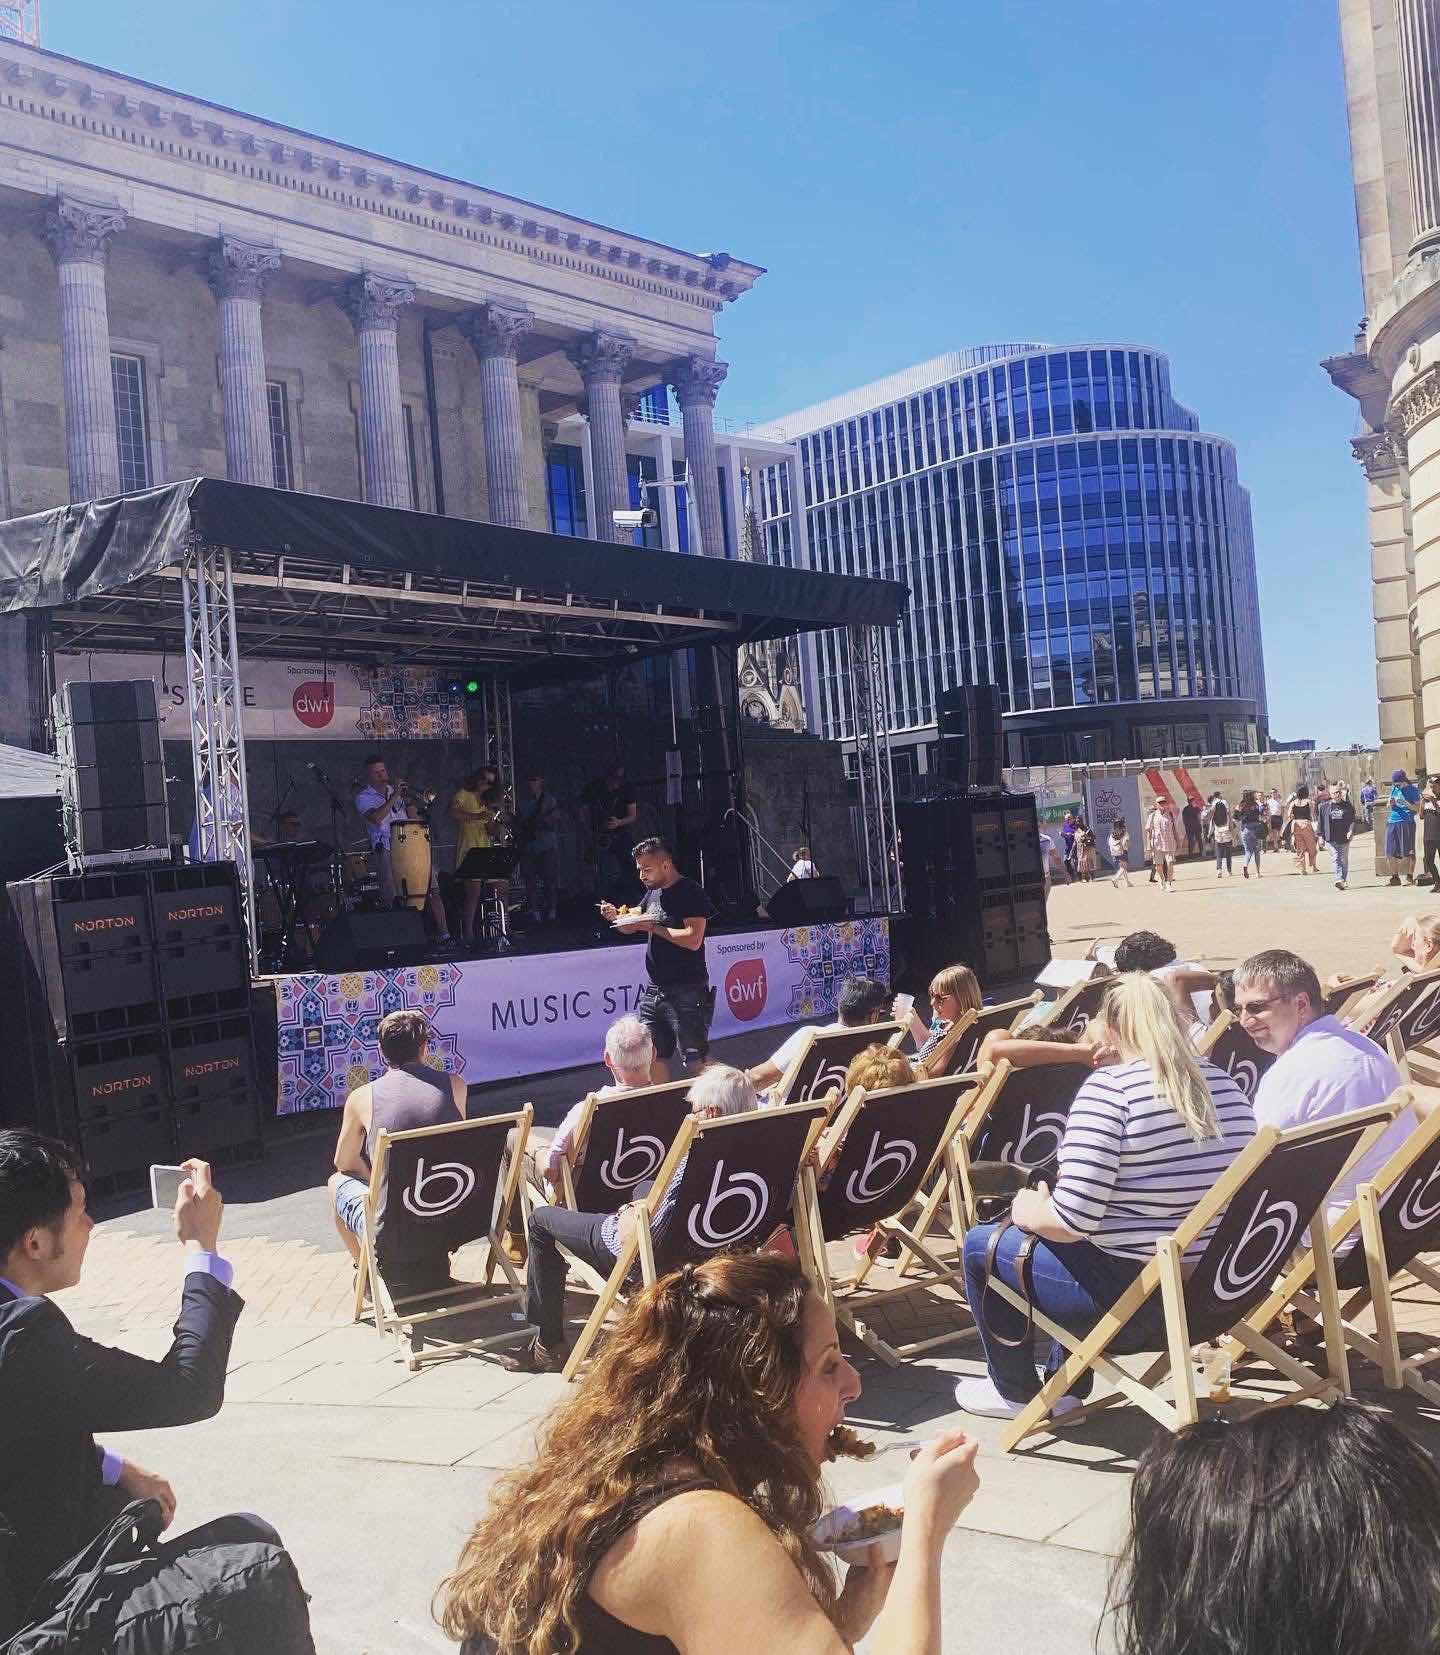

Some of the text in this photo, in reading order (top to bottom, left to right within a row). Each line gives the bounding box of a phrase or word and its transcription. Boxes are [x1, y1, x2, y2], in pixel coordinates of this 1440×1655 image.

[168, 904, 225, 921] NORTON
[73, 915, 136, 932] NORTON
[717, 940, 766, 955] Sponsored by
[729, 974, 764, 1003] dwf
[491, 990, 592, 1031] MUSIC
[184, 1056, 240, 1077] NORTON
[92, 1075, 152, 1097] NORTON
